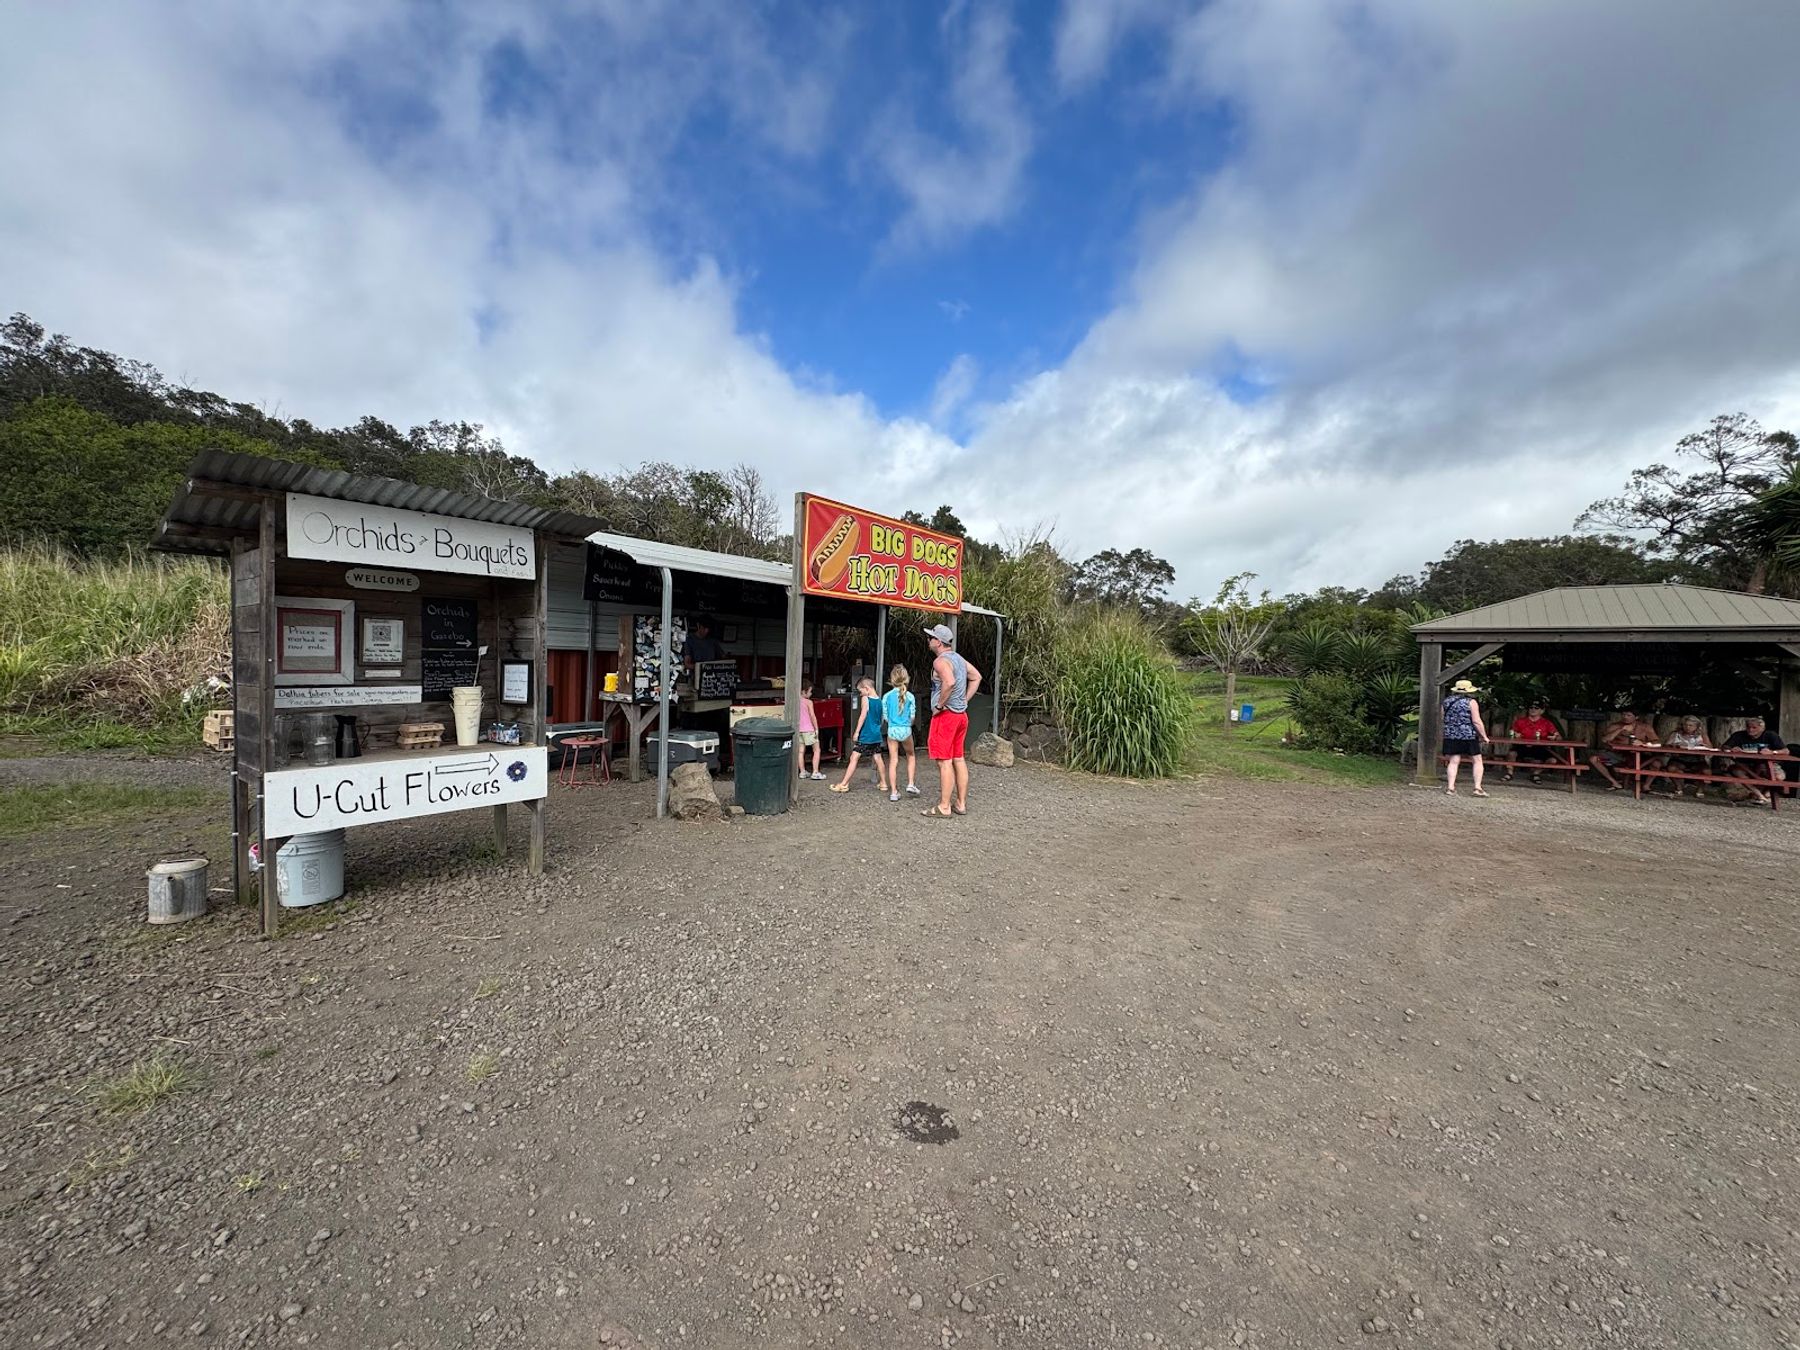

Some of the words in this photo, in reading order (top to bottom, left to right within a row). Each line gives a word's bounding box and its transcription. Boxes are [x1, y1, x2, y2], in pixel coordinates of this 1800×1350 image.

[302, 512, 416, 554] Orchids
[434, 528, 528, 574] Bouquets
[870, 524, 905, 557] BIG
[912, 535, 957, 569] DOGS
[353, 573, 413, 586] WELCOME
[904, 566, 959, 605] DOGS
[430, 630, 464, 640] Gazebo
[443, 618, 454, 628] in
[293, 776, 392, 819] U-Cut
[405, 771, 501, 806] Flowers
